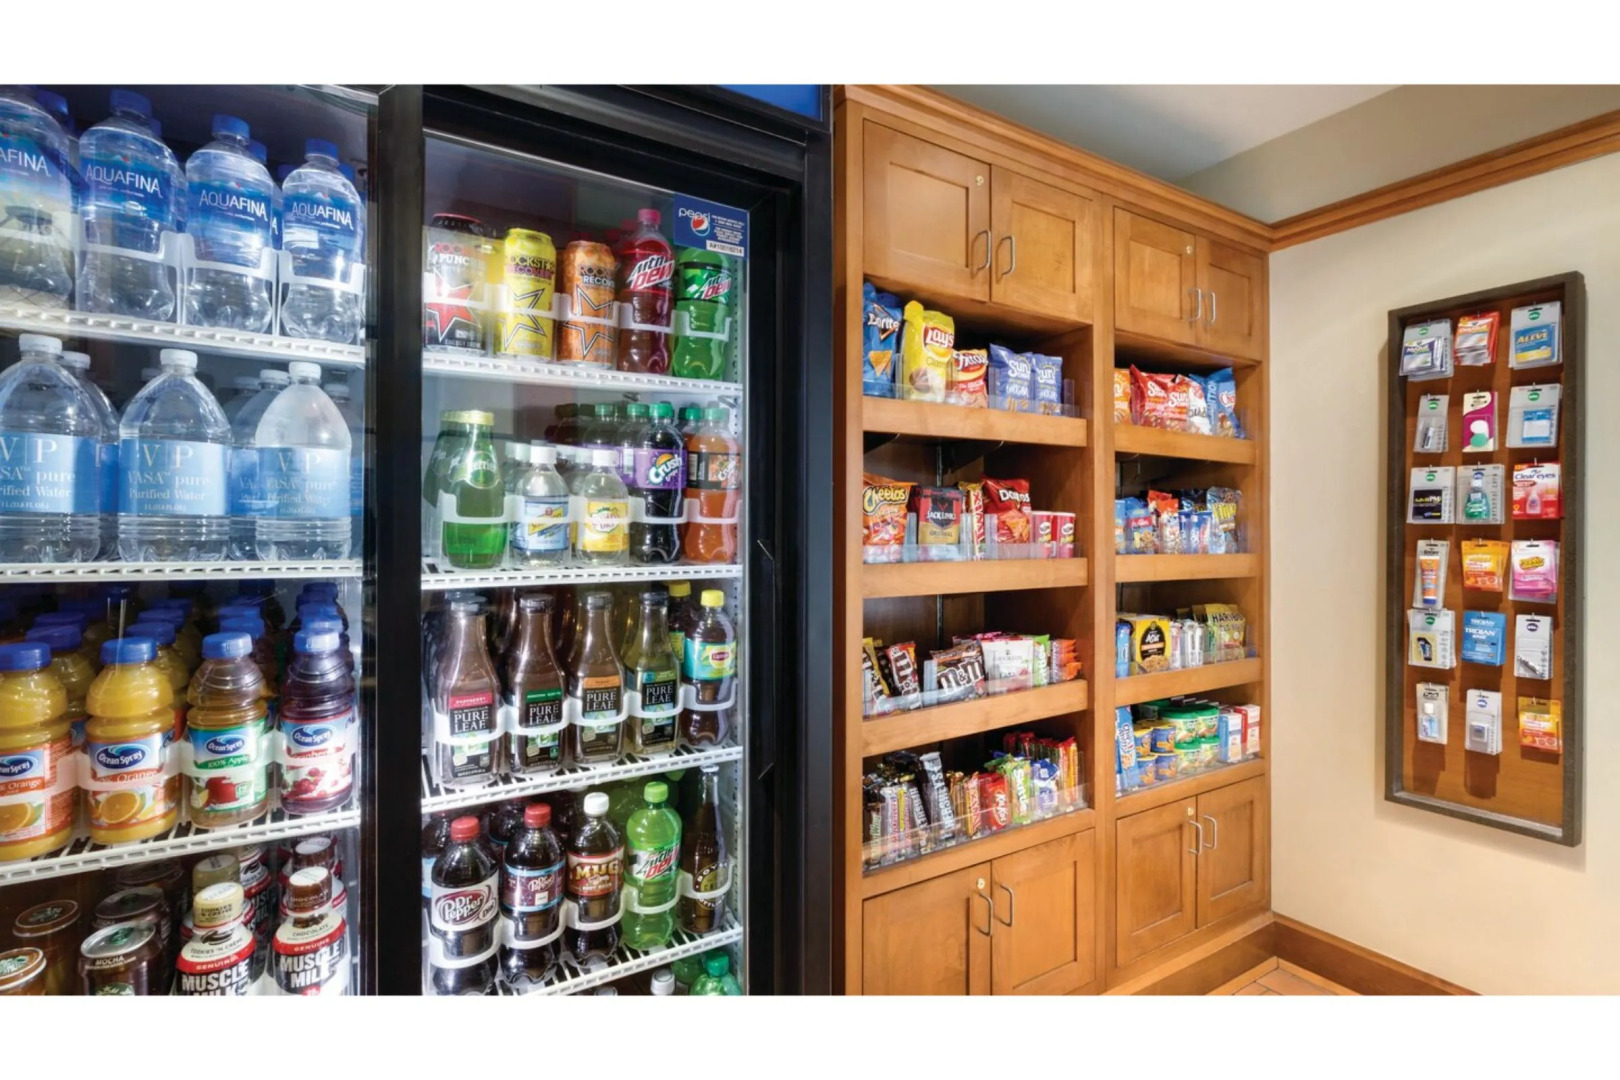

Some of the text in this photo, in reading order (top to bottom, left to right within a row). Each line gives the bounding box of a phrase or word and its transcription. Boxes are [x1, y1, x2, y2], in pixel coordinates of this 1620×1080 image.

[84, 163, 164, 199] AQUAFINA
[199, 189, 269, 222] AQUAFINA
[291, 201, 354, 231] AQUAFINA
[678, 207, 711, 223] pepsi
[34, 438, 59, 465] P
[175, 445, 195, 470] P
[649, 453, 683, 485] Crush
[36, 469, 77, 489] pure
[174, 474, 210, 491] pure
[35, 486, 73, 498] Water
[128, 489, 206, 502] Purified Water
[998, 489, 1031, 503] Doritos
[863, 486, 906, 515] Cheetos
[586, 691, 617, 703] PURE
[646, 684, 674, 696] PURE
[586, 701, 615, 712] LEAF
[646, 694, 672, 705] LEAF
[454, 710, 489, 723] PURE
[529, 705, 560, 718] PURE
[454, 720, 487, 733] LEAF
[529, 714, 557, 726] LEAF
[207, 738, 245, 752] Ocean Spray
[98, 751, 143, 766] Ocean Spray
[10, 761, 31, 774] Spray
[8, 778, 42, 790] Orange
[575, 859, 620, 880] MUG
[443, 895, 483, 921] Pepper
[455, 894, 473, 909] Dr
[292, 923, 329, 937] CHOCOLATE
[280, 936, 341, 974] MUSCLE
[181, 957, 250, 992] MUSCLE
